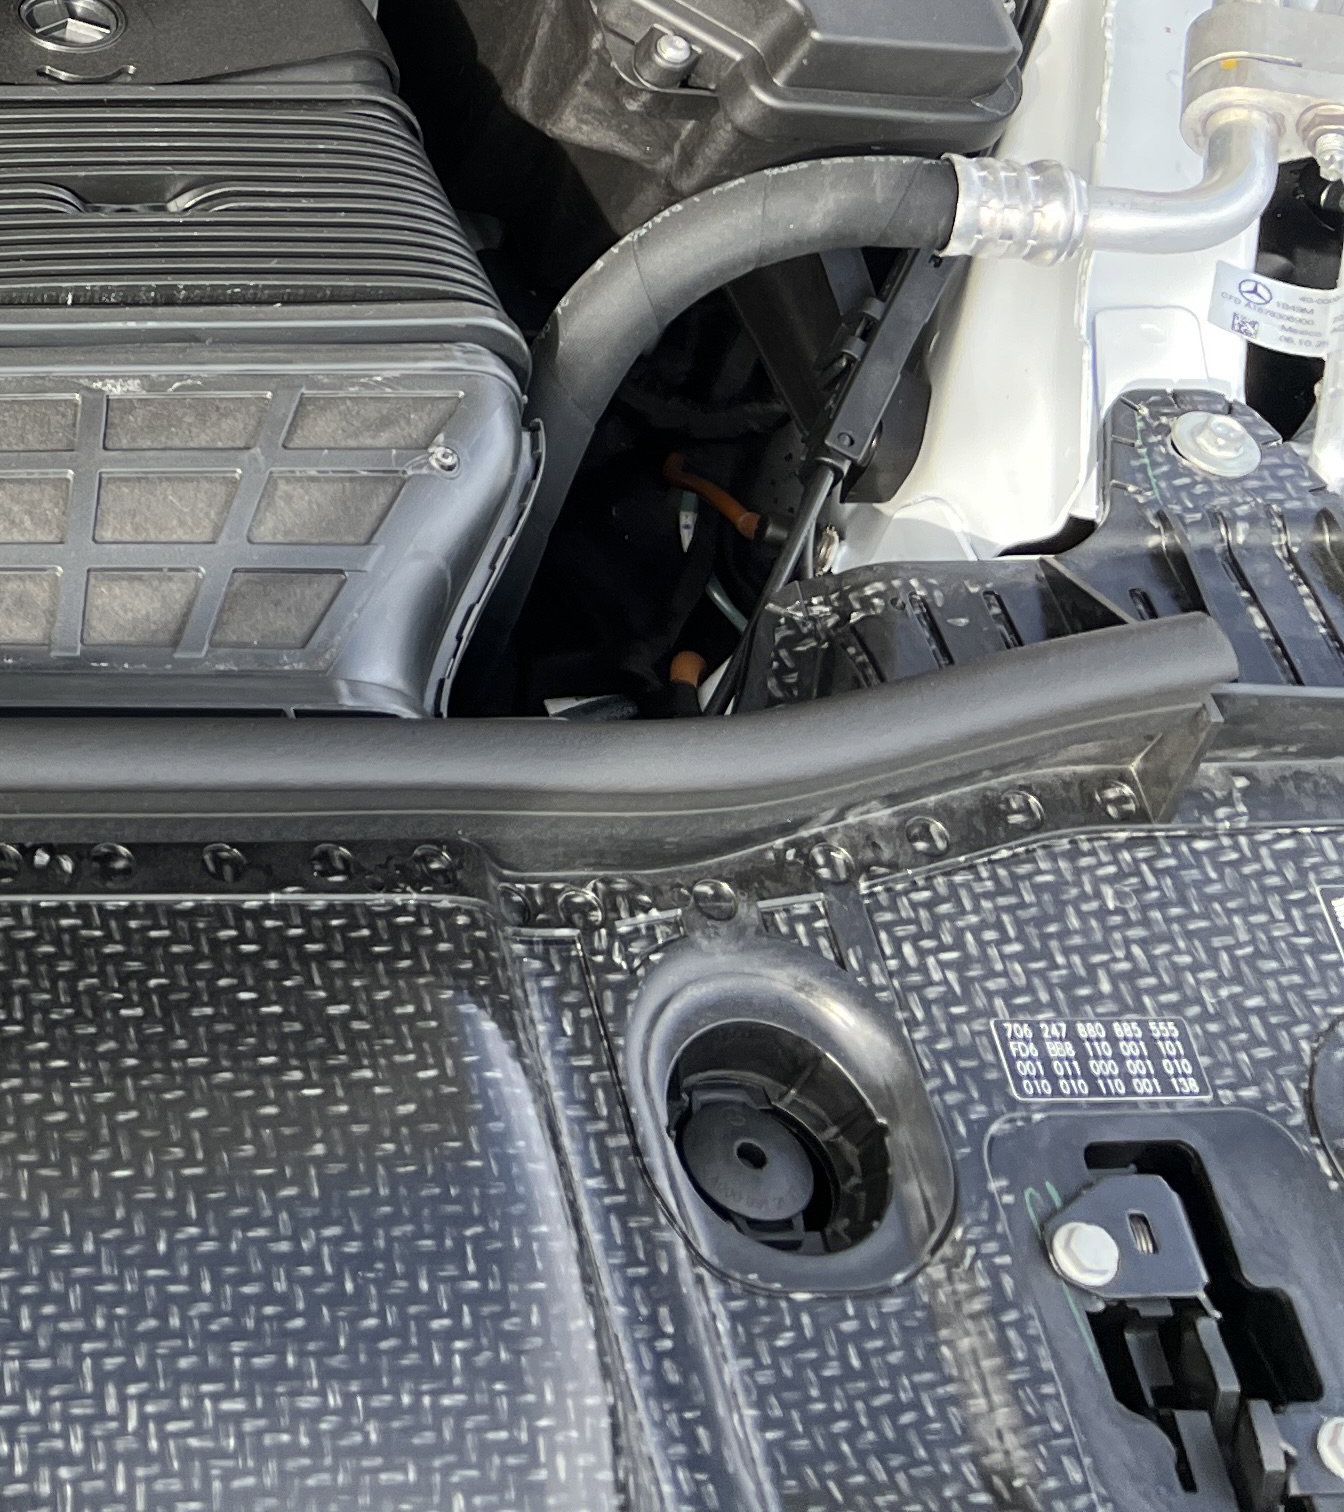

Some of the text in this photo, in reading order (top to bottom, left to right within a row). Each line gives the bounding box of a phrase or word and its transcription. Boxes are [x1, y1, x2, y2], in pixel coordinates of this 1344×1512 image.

[1003, 1022, 1033, 1039] 706
[1039, 1022, 1067, 1039] 247
[1148, 1021, 1179, 1037] 555
[1009, 1040, 1039, 1058] FD6
[1084, 1040, 1112, 1057] 110
[1119, 1040, 1148, 1057] 001
[1156, 1040, 1185, 1056] 101
[1016, 1058, 1193, 1077] 001 011 000 001 010
[1022, 1078, 1052, 1095] 010
[1059, 1078, 1089, 1095] 010
[1097, 1078, 1126, 1095] 110
[1132, 1077, 1162, 1095] 001
